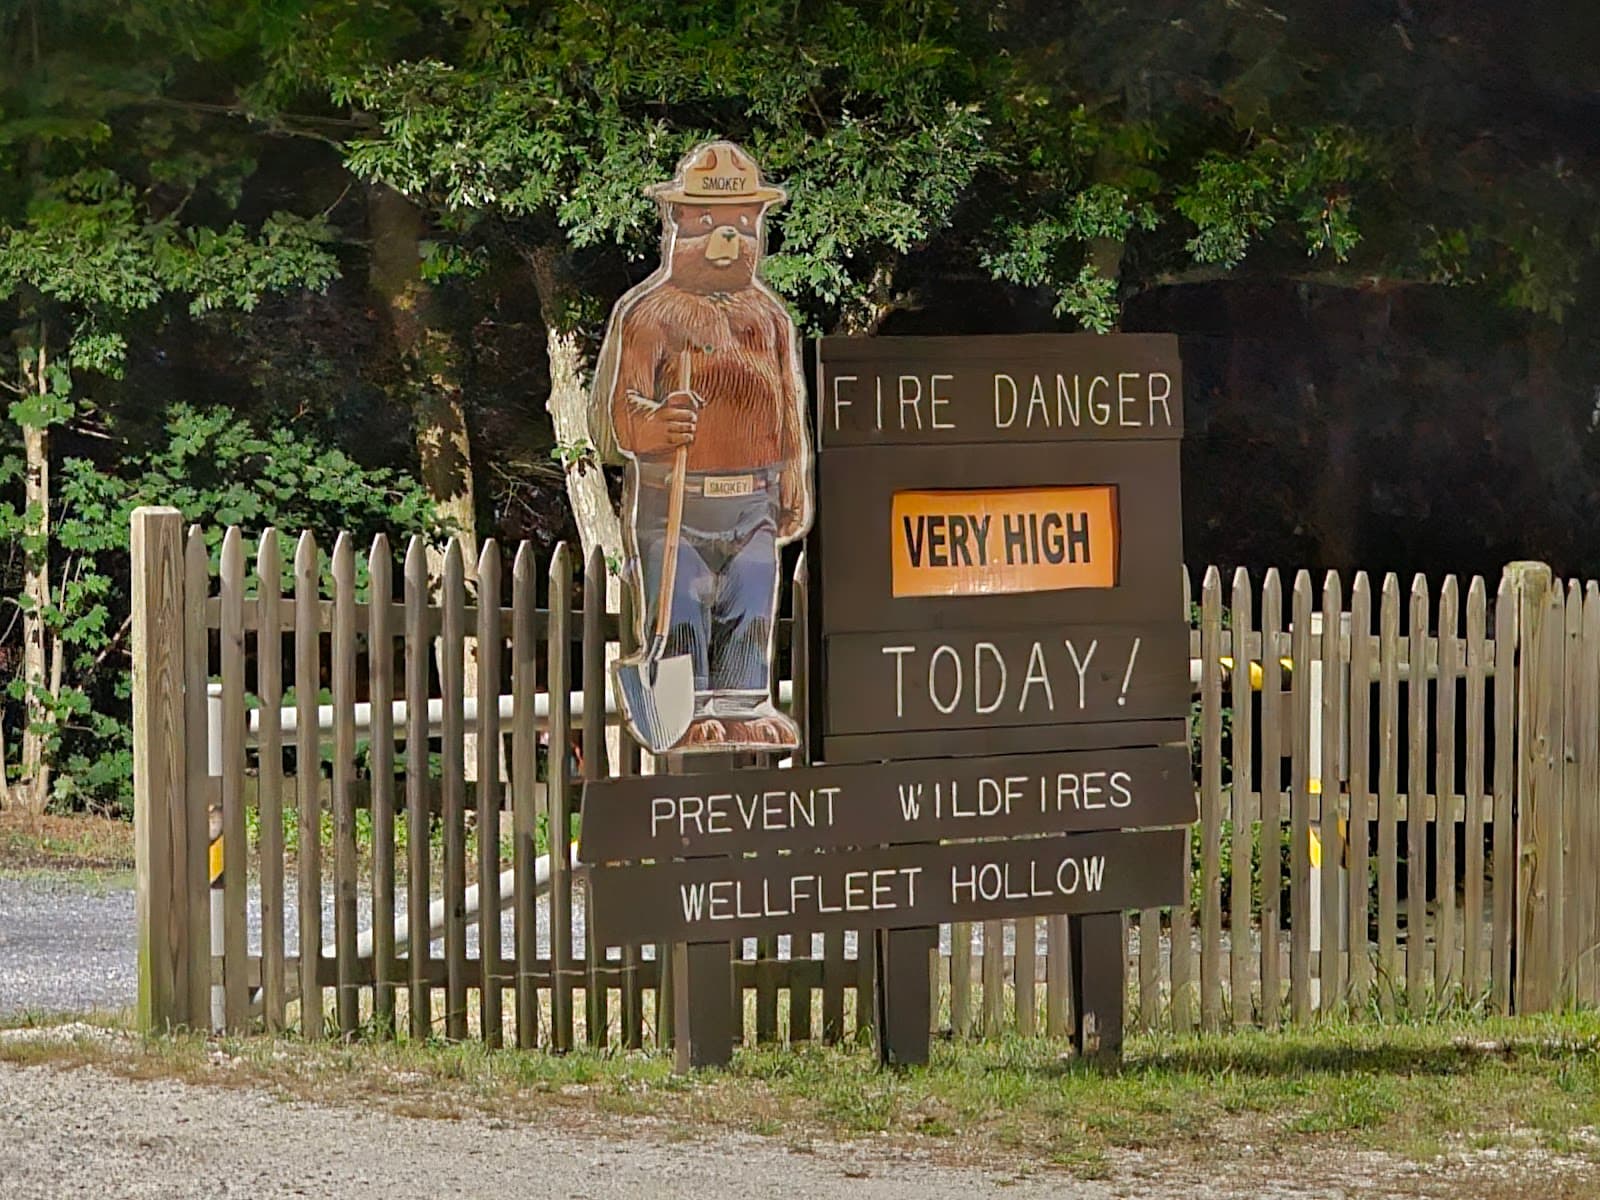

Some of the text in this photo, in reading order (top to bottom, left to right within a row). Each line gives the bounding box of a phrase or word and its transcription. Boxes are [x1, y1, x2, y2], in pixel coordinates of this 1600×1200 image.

[701, 177, 747, 191] SMOKEY
[833, 373, 1172, 431] FIRE DANGER
[903, 511, 1091, 568] VERY HIGH
[881, 637, 1141, 718] TODAY!
[651, 771, 1133, 838] PREVENT WILDFIRES
[680, 855, 1106, 923] WELLFLEET HOLLOW
